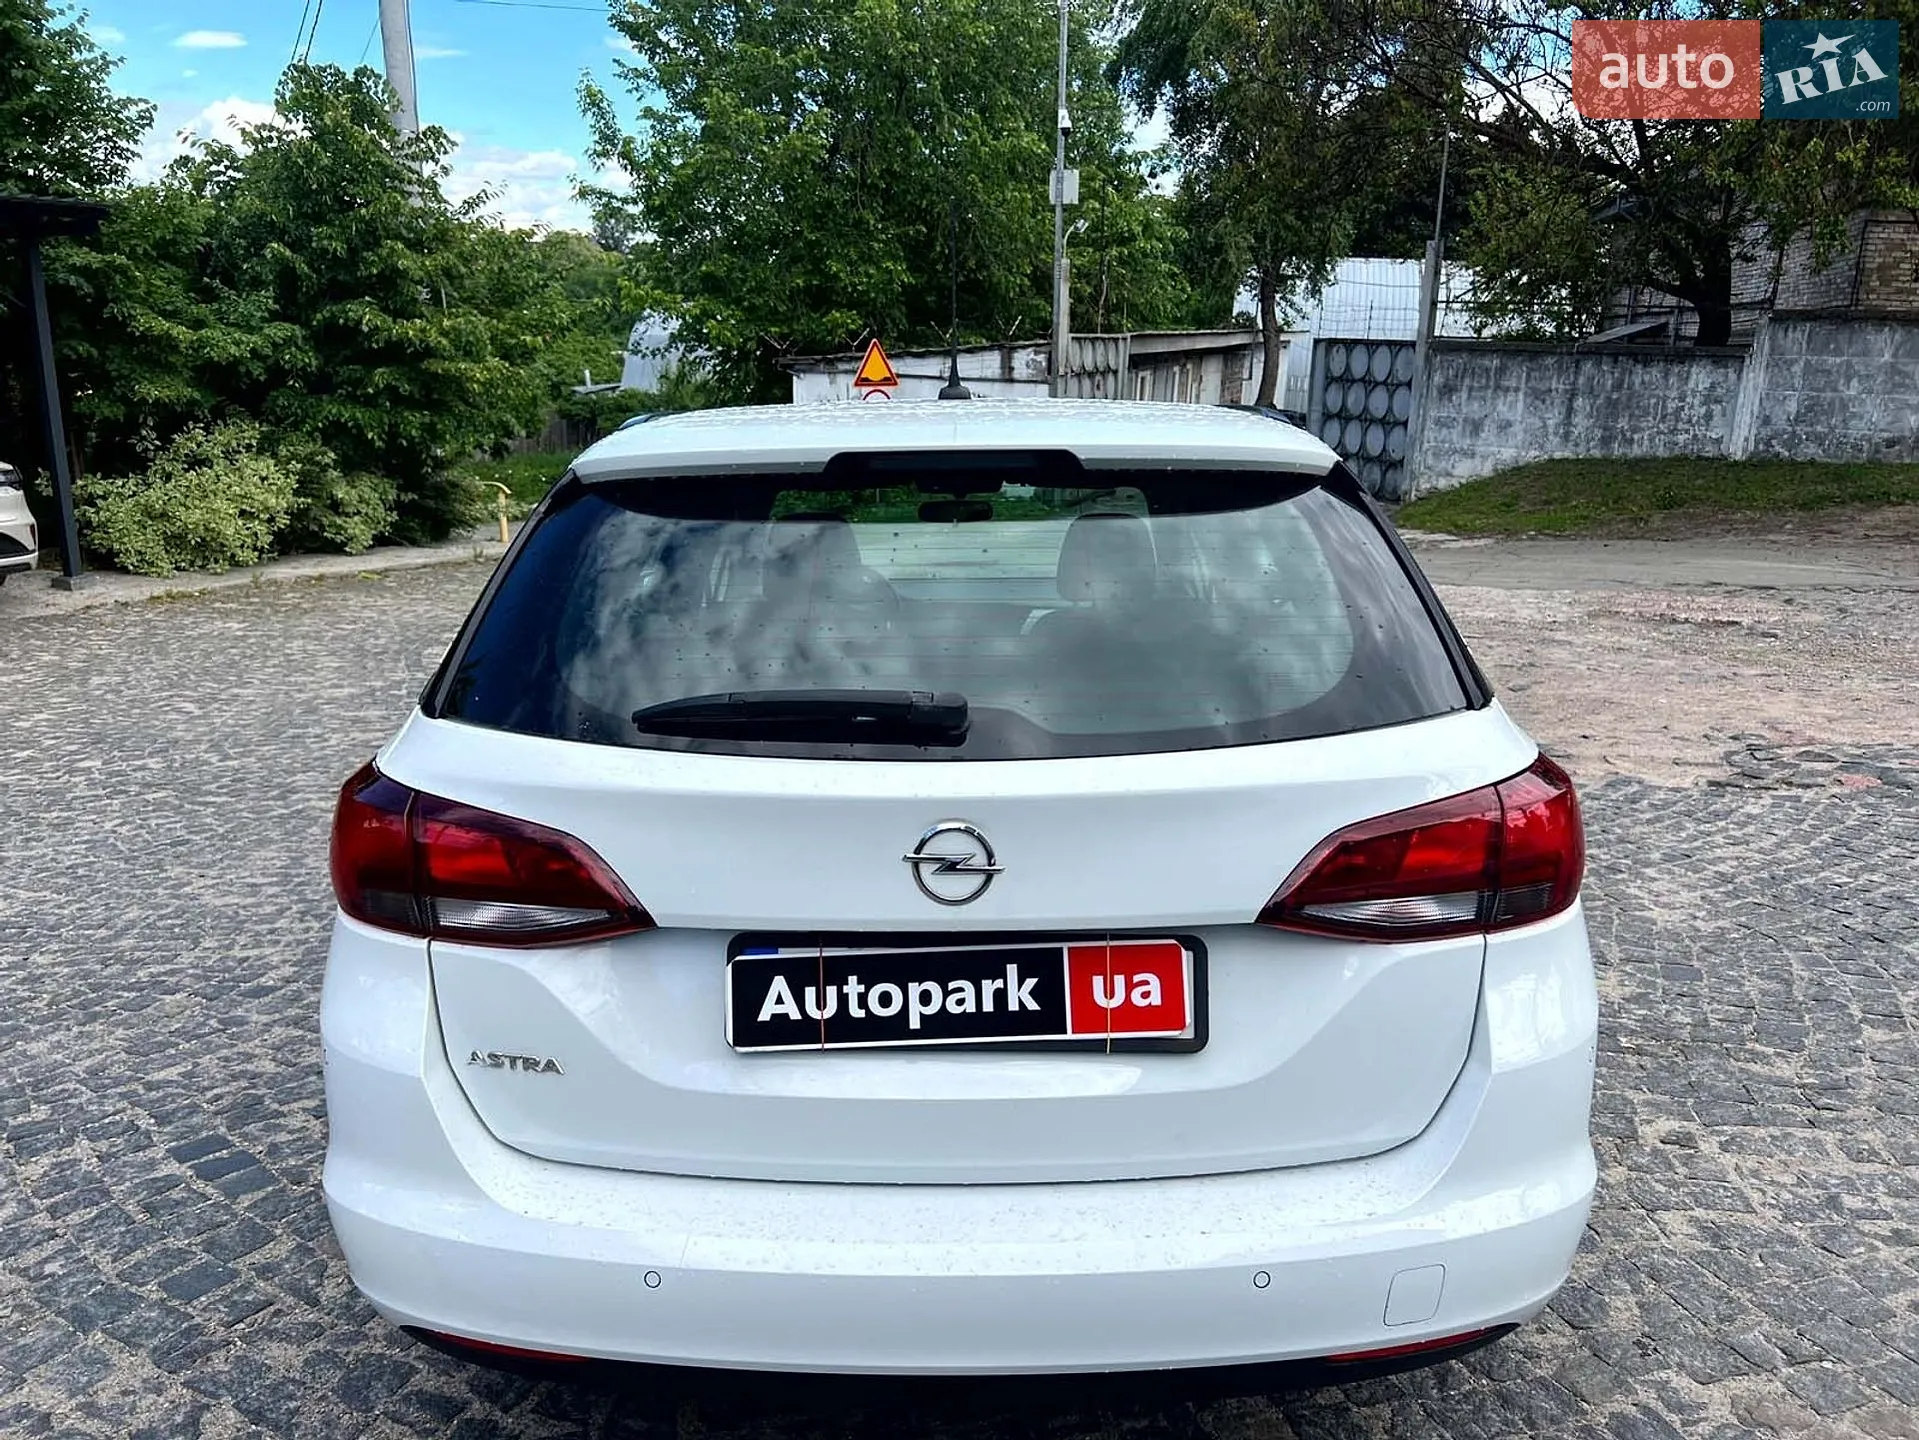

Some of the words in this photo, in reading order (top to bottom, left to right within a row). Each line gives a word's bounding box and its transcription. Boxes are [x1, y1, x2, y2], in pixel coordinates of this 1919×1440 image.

[757, 963, 1041, 1030] Autopark
[1091, 972, 1162, 1009] ua
[467, 1049, 566, 1076] ASTRA
